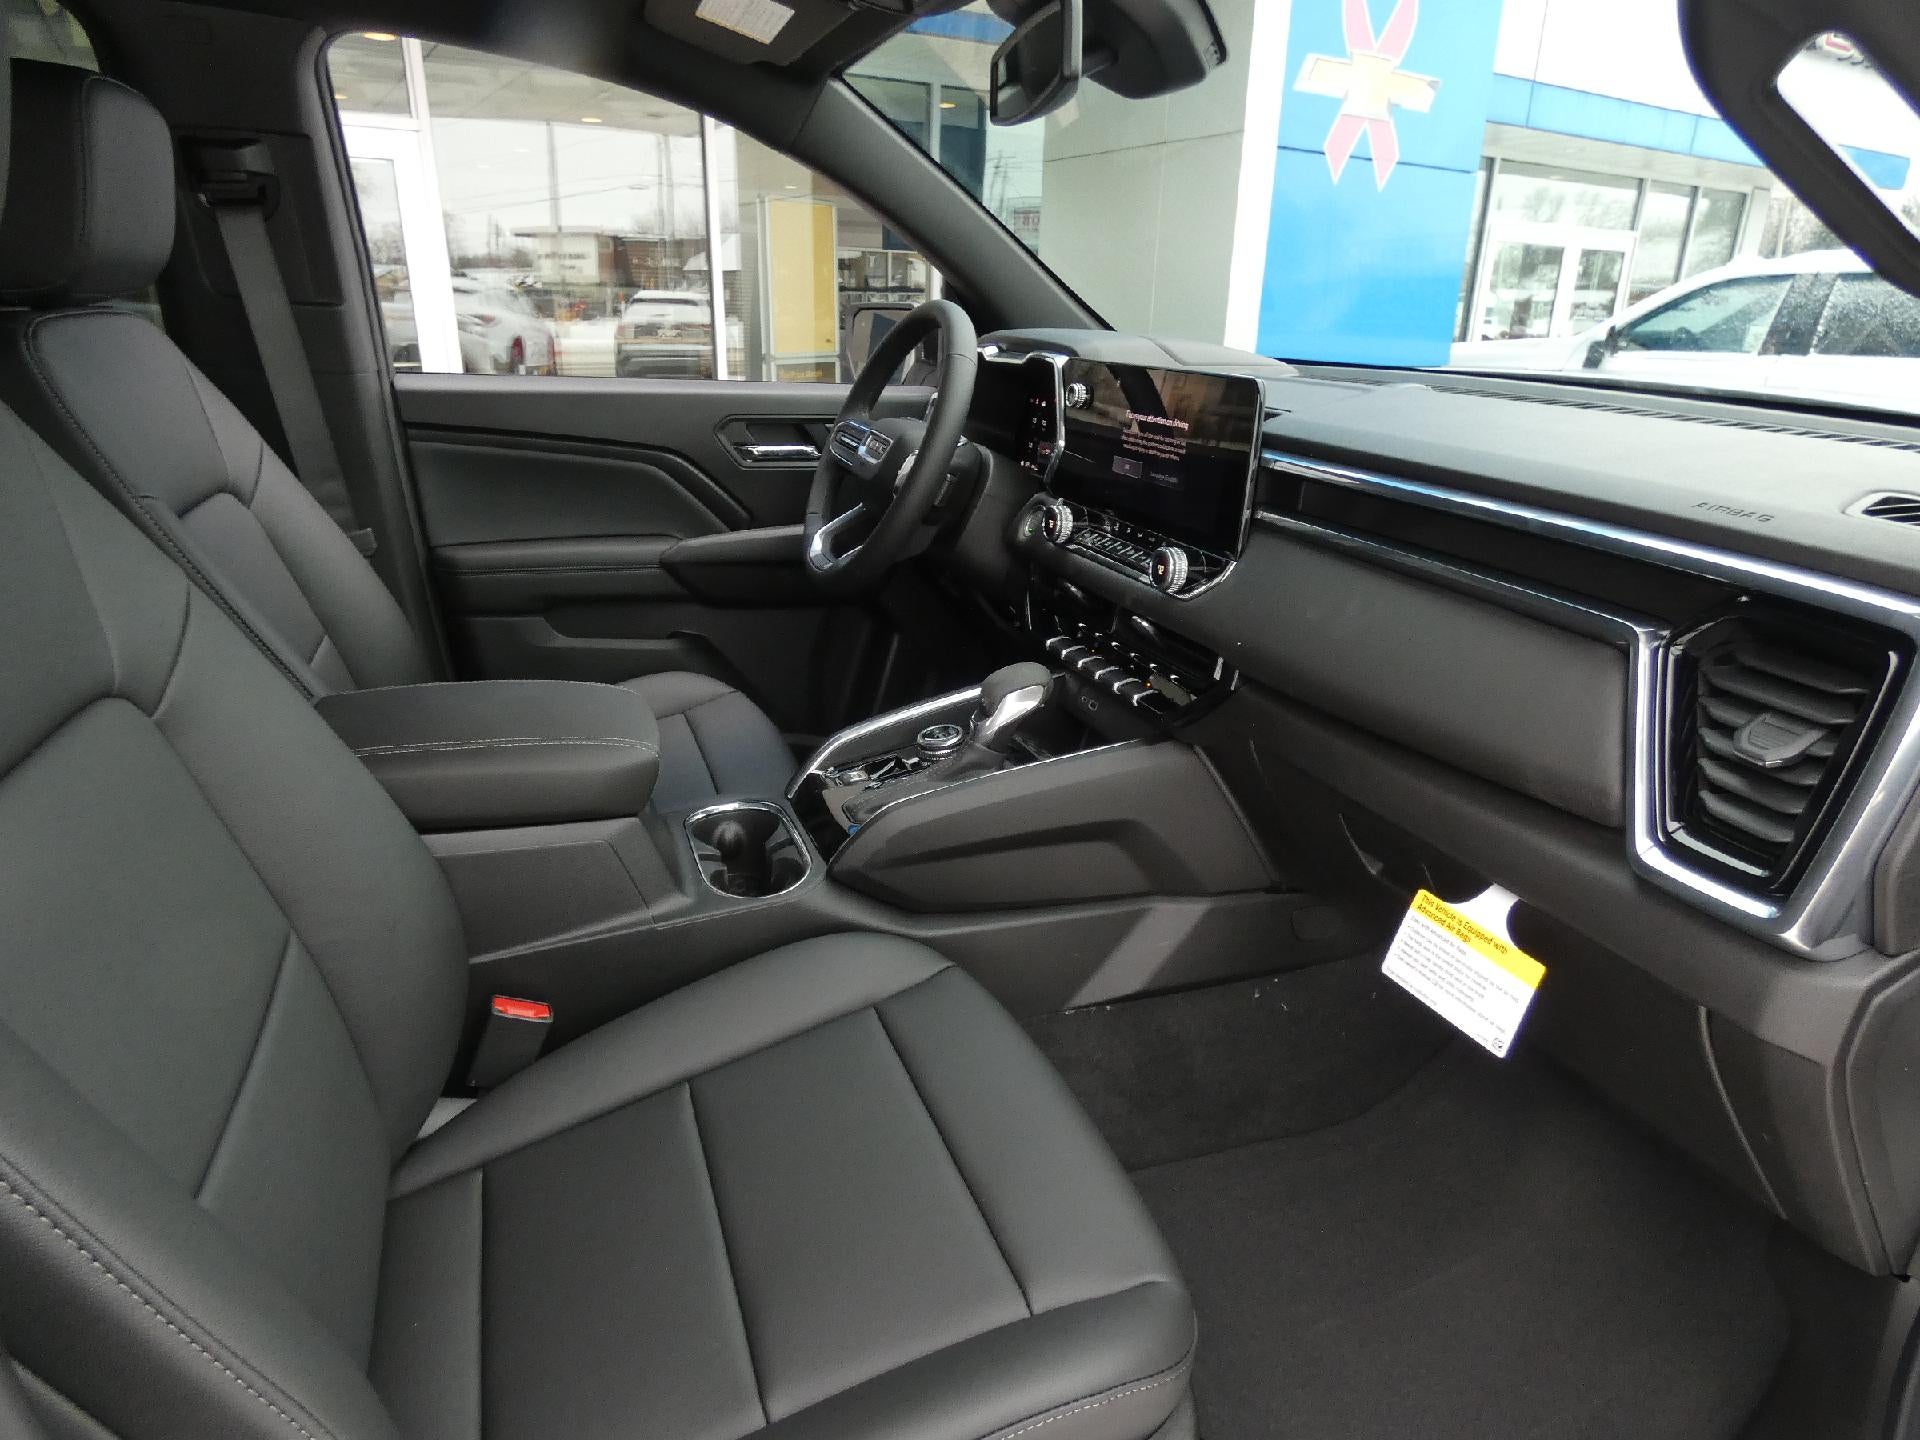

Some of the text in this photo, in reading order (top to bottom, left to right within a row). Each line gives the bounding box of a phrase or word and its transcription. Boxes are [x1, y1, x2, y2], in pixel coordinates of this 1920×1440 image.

[1690, 502, 1775, 522] AIRBAG
[1417, 903, 1471, 943] Advanced Air Bags
[1421, 894, 1435, 908] This
[1435, 903, 1457, 921] Vehicle
[1463, 921, 1494, 945] Equipped
[1493, 941, 1508, 955] with
